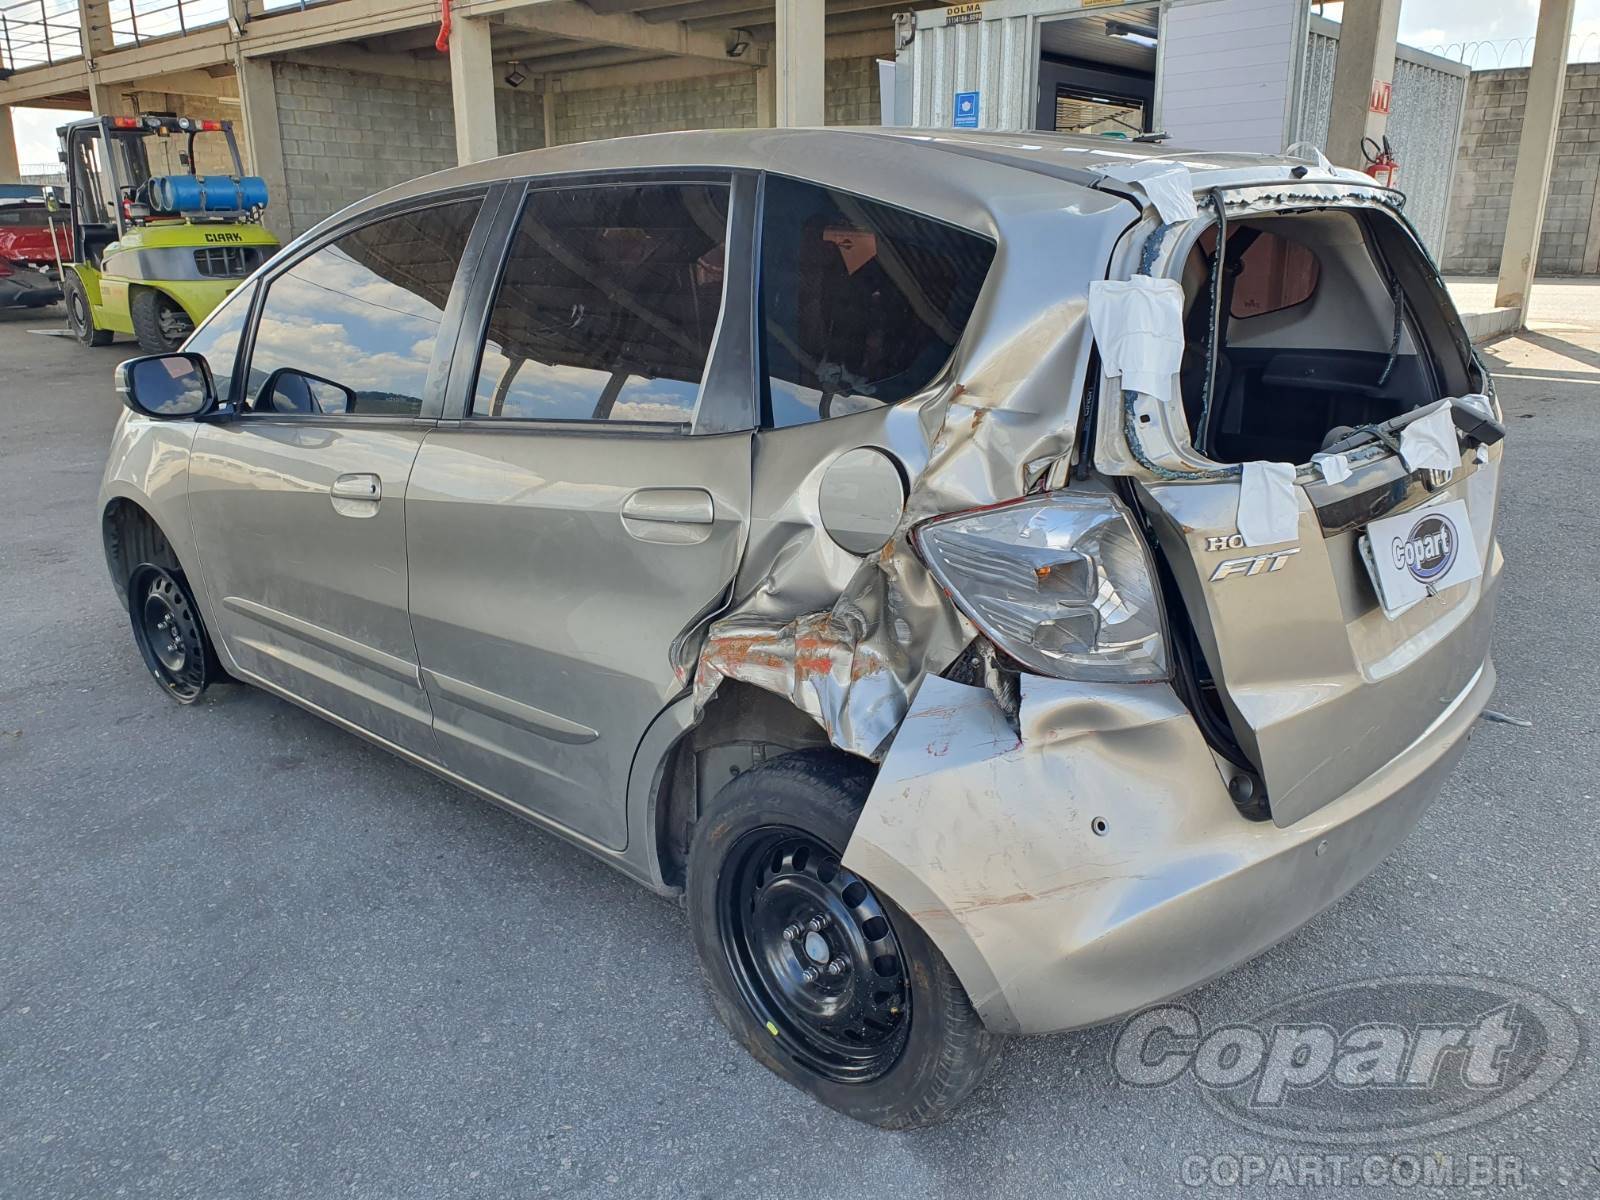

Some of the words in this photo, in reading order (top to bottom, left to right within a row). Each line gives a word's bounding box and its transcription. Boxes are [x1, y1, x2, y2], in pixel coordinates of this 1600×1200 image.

[947, 4, 981, 15] DOLMA
[204, 233, 243, 243] CLARK
[1392, 522, 1450, 571] Copart
[1208, 547, 1301, 582] FIT
